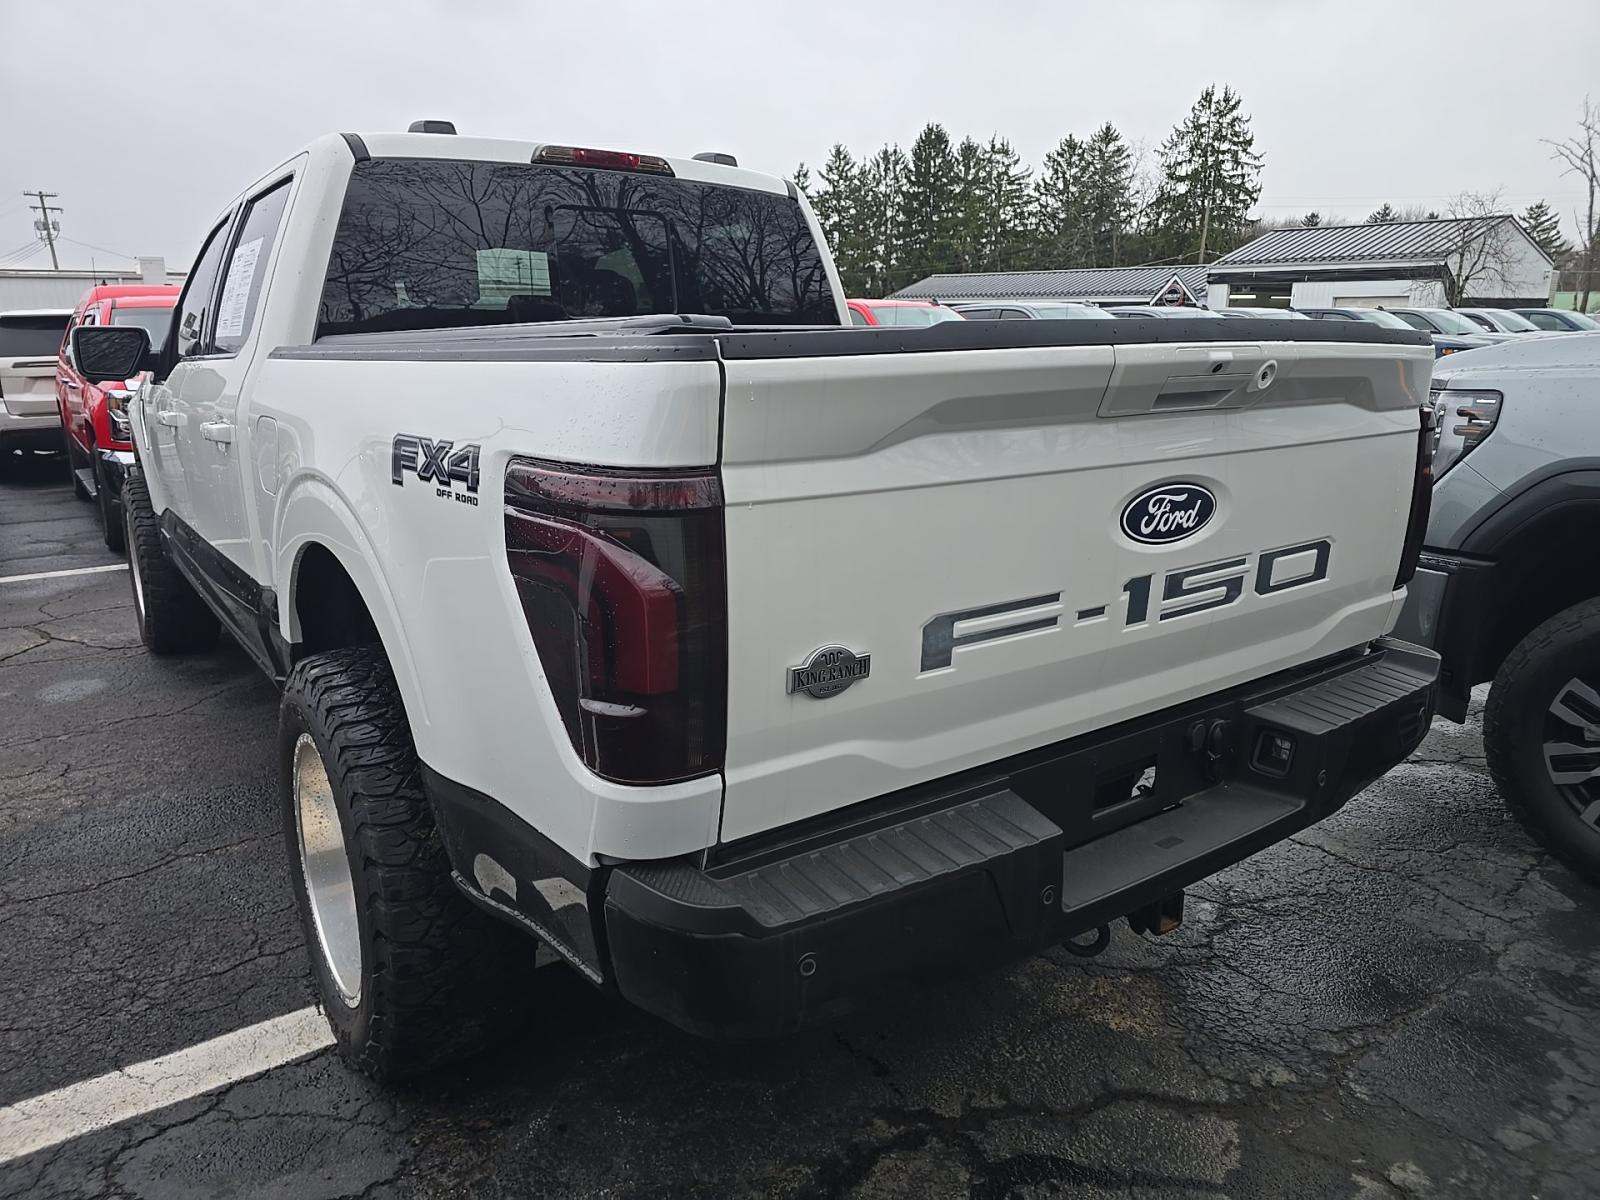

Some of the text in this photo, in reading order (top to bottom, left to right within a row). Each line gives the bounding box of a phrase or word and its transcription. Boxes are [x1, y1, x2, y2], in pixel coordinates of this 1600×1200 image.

[391, 432, 481, 494] FX4
[436, 488, 479, 506] OFF ROAD
[1141, 493, 1201, 534] Ford
[918, 538, 1334, 677] F-150
[797, 659, 868, 688] KING RANCH
